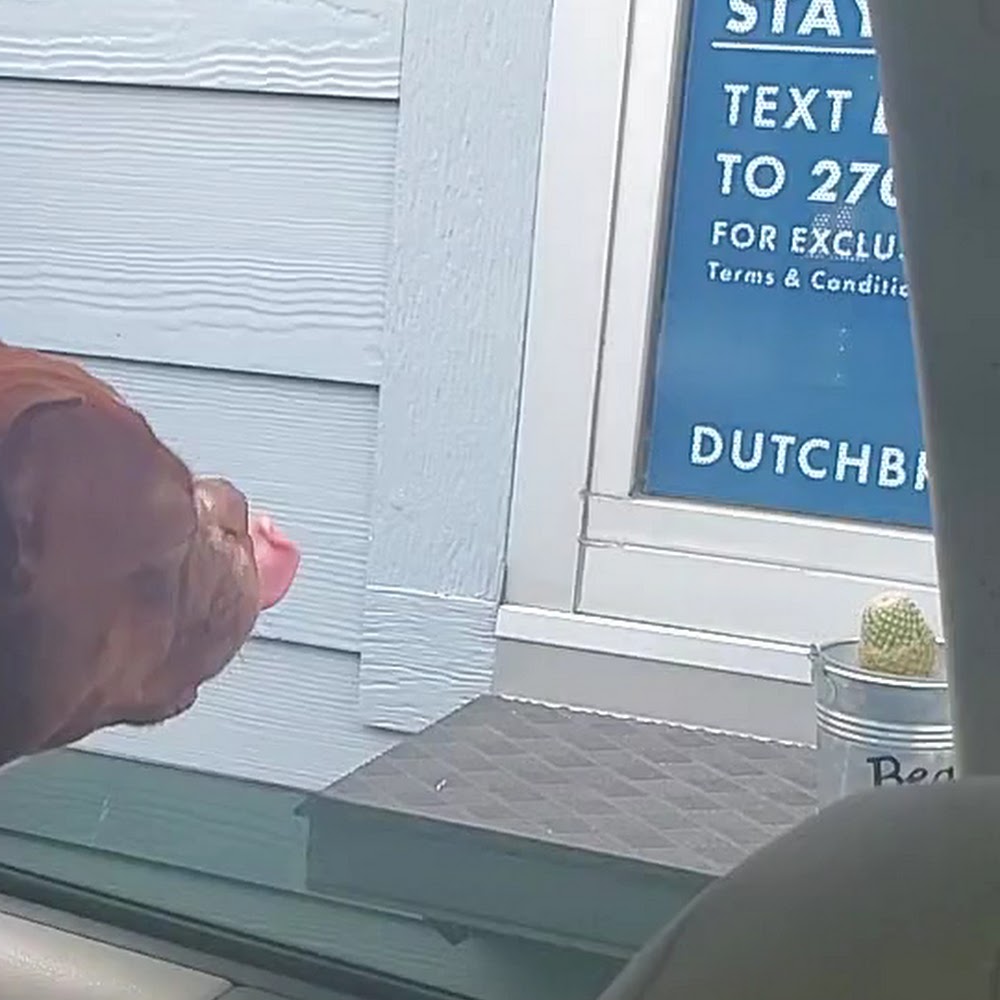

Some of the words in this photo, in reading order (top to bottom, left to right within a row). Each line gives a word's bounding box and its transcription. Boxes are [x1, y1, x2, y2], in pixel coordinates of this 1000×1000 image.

[723, 83, 852, 132] TEXT
[716, 153, 786, 198] TO
[711, 220, 777, 251] FOR
[790, 226, 905, 260] EXCLU
[707, 261, 775, 286] Terms
[784, 268, 800, 288] &
